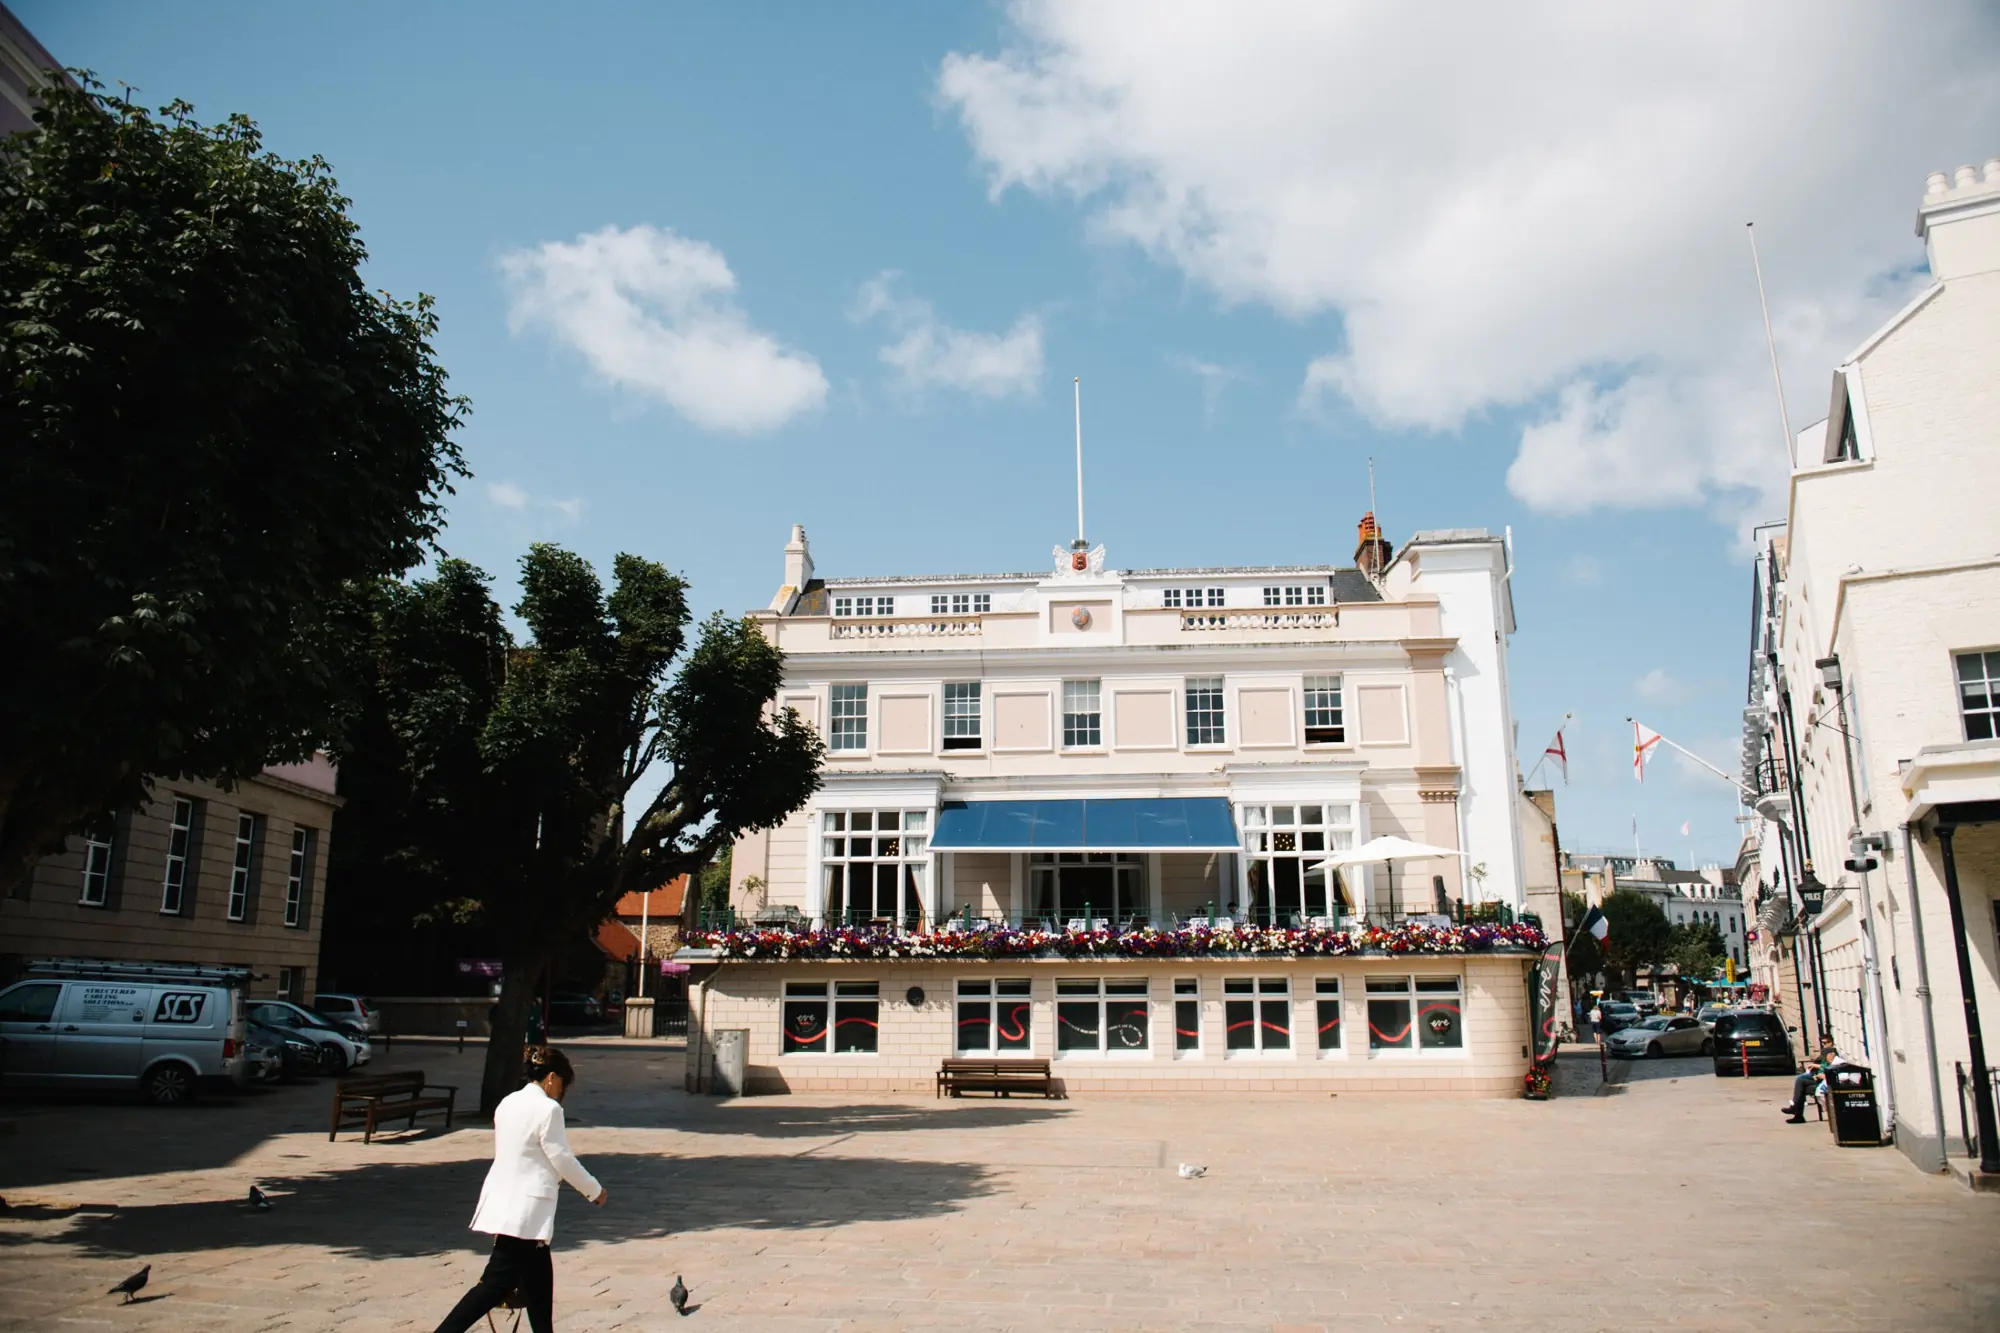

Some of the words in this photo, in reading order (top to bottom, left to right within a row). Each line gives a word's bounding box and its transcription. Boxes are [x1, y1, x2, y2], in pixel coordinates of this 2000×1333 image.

[1804, 892, 1822, 901] POLICE
[1540, 966, 1552, 1013] eve
[157, 995, 203, 1021] SCS
[795, 1014, 816, 1022] eve
[1430, 1018, 1450, 1028] eve
